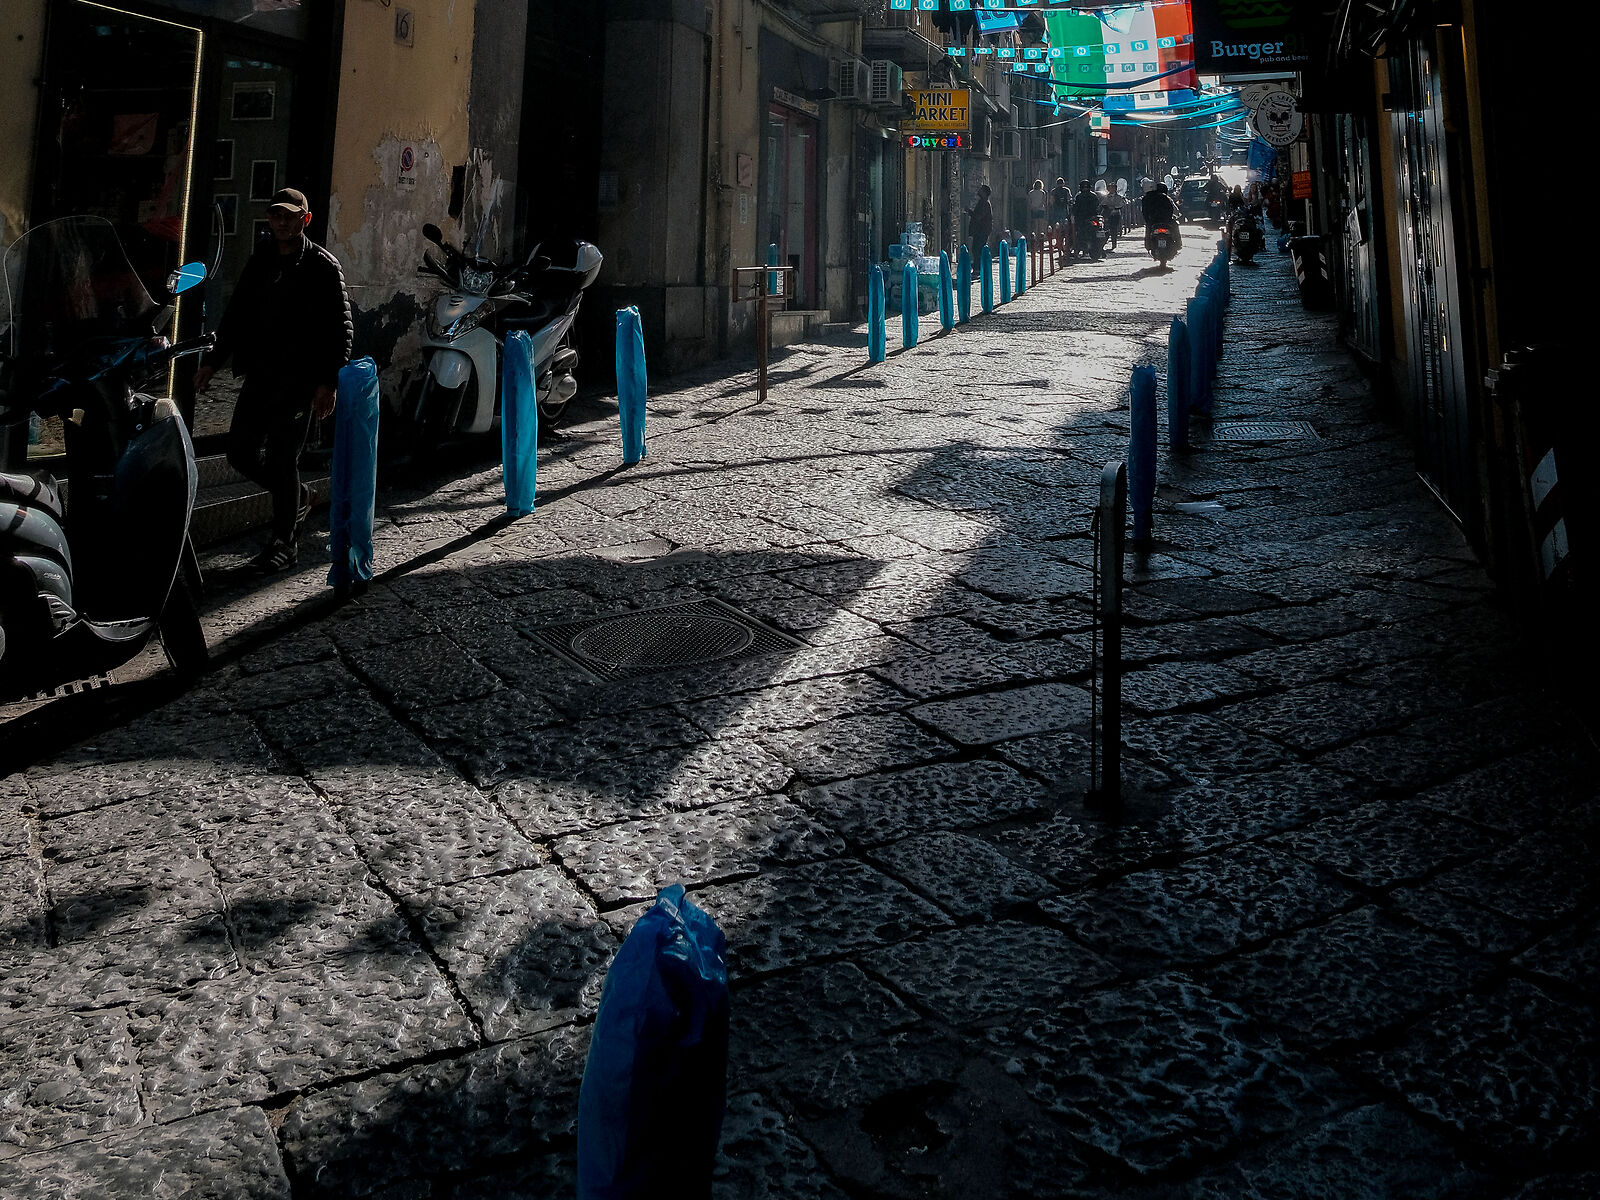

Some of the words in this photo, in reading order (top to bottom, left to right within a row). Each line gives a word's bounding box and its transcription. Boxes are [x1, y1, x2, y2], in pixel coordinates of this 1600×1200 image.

[1209, 40, 1284, 60] Burger
[1260, 55, 1274, 64] pub
[919, 92, 952, 106] MINI
[916, 107, 967, 121] ARKET
[908, 135, 963, 148] Ouvert
